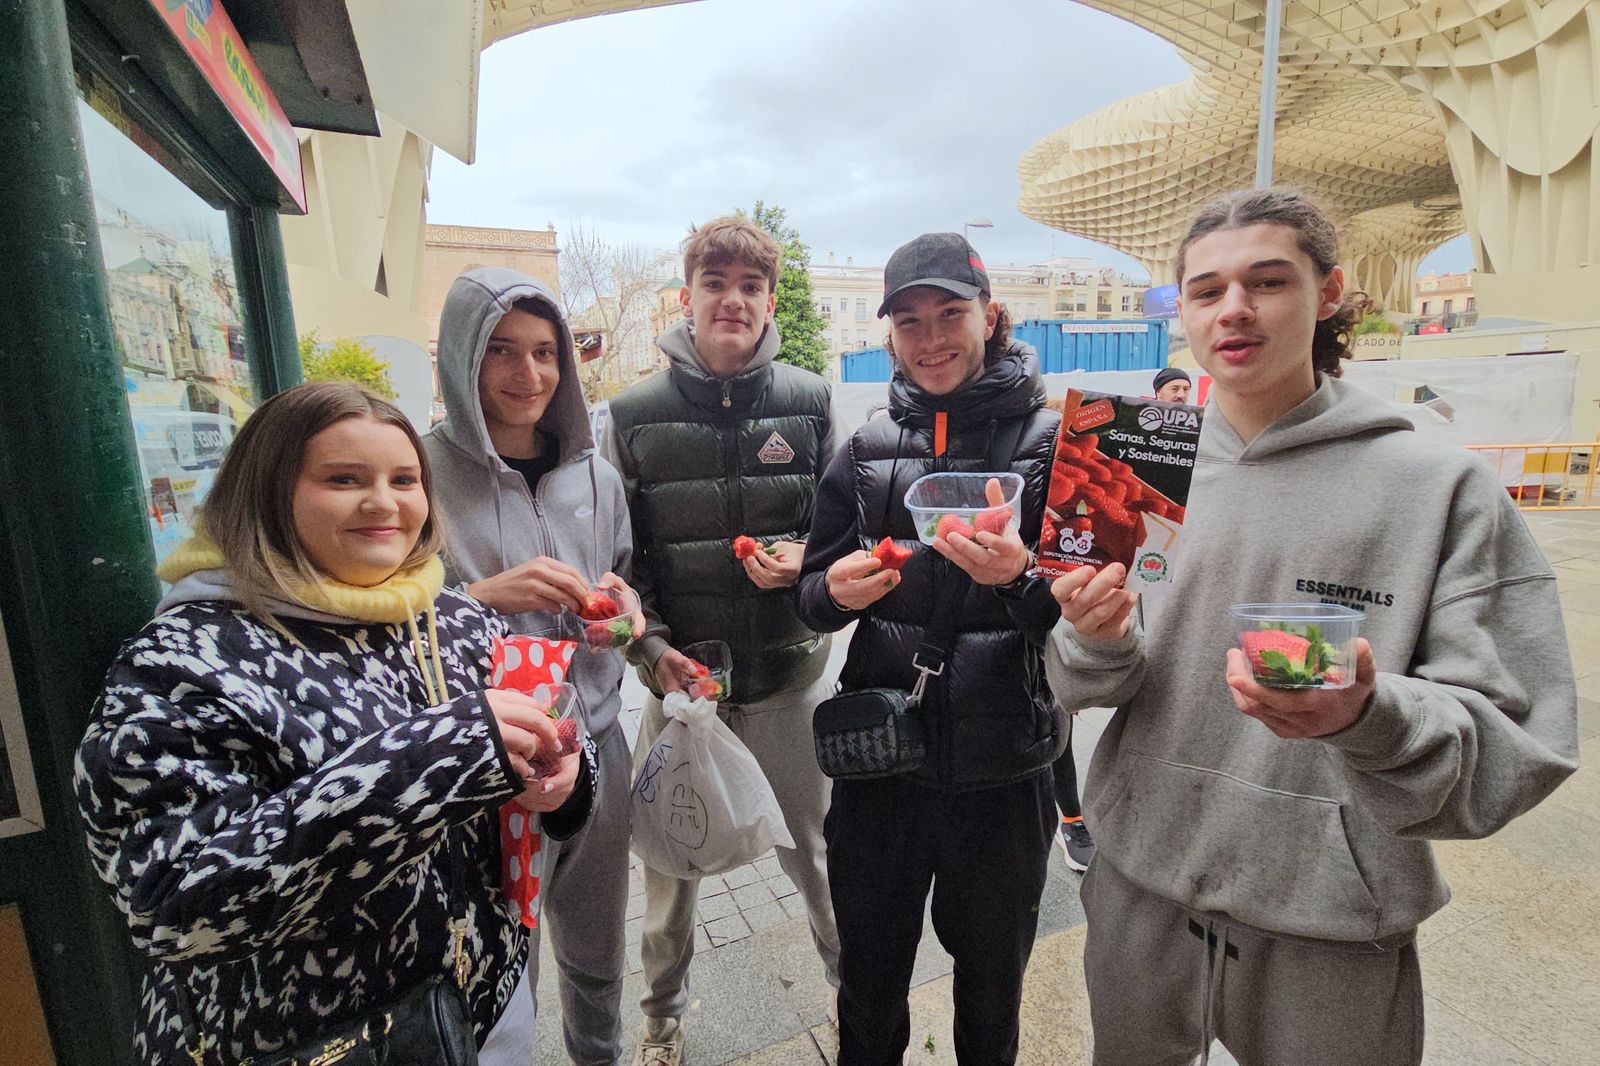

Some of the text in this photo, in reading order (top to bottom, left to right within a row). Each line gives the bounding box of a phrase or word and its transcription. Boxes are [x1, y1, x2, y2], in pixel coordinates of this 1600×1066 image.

[1357, 338, 1386, 346] CADO
[1163, 409, 1199, 428] UPA
[1108, 429, 1147, 446] Sanas,
[1149, 435, 1197, 452] Seguras
[1118, 447, 1194, 467] y Sostenibles
[1295, 579, 1394, 607] ESSENTIALS
